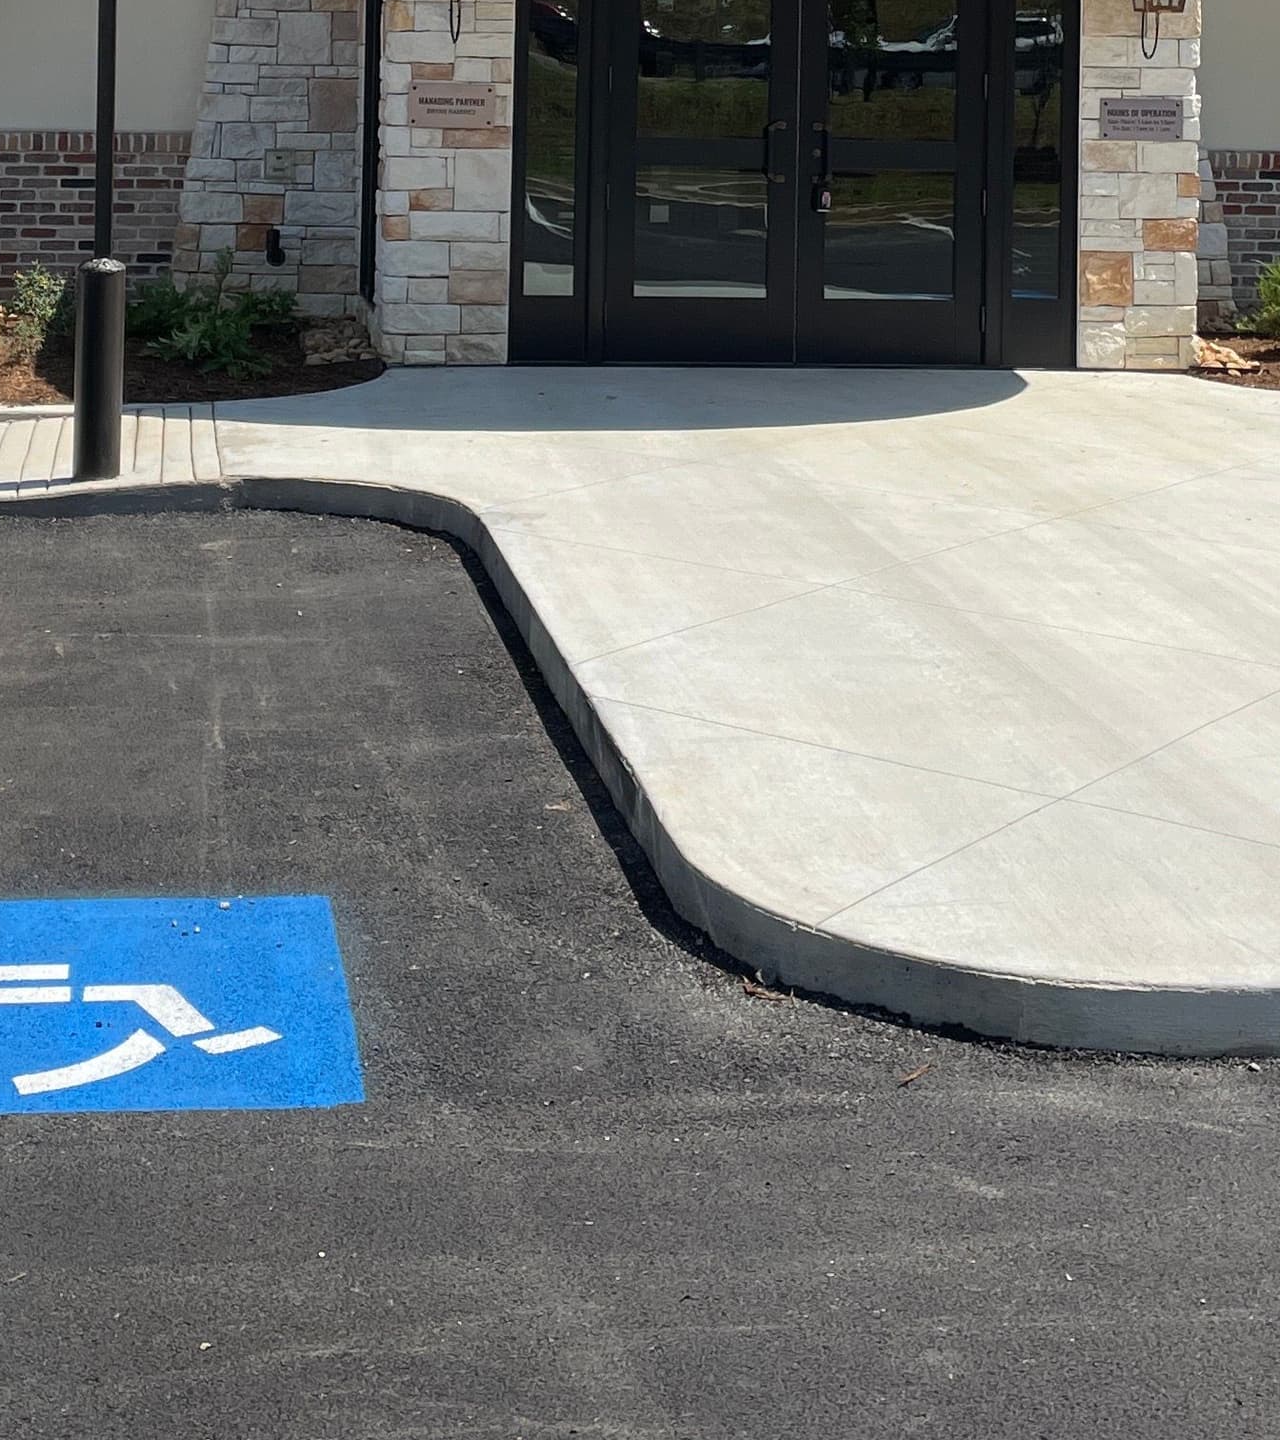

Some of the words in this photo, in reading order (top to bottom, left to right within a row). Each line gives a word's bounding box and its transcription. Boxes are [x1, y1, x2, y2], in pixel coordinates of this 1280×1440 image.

[418, 97, 454, 106] MANAGING
[455, 98, 485, 107] PARTNER
[1107, 109, 1130, 117] HOURS
[1131, 109, 1139, 117] OF
[1141, 109, 1177, 117] OPERATION
